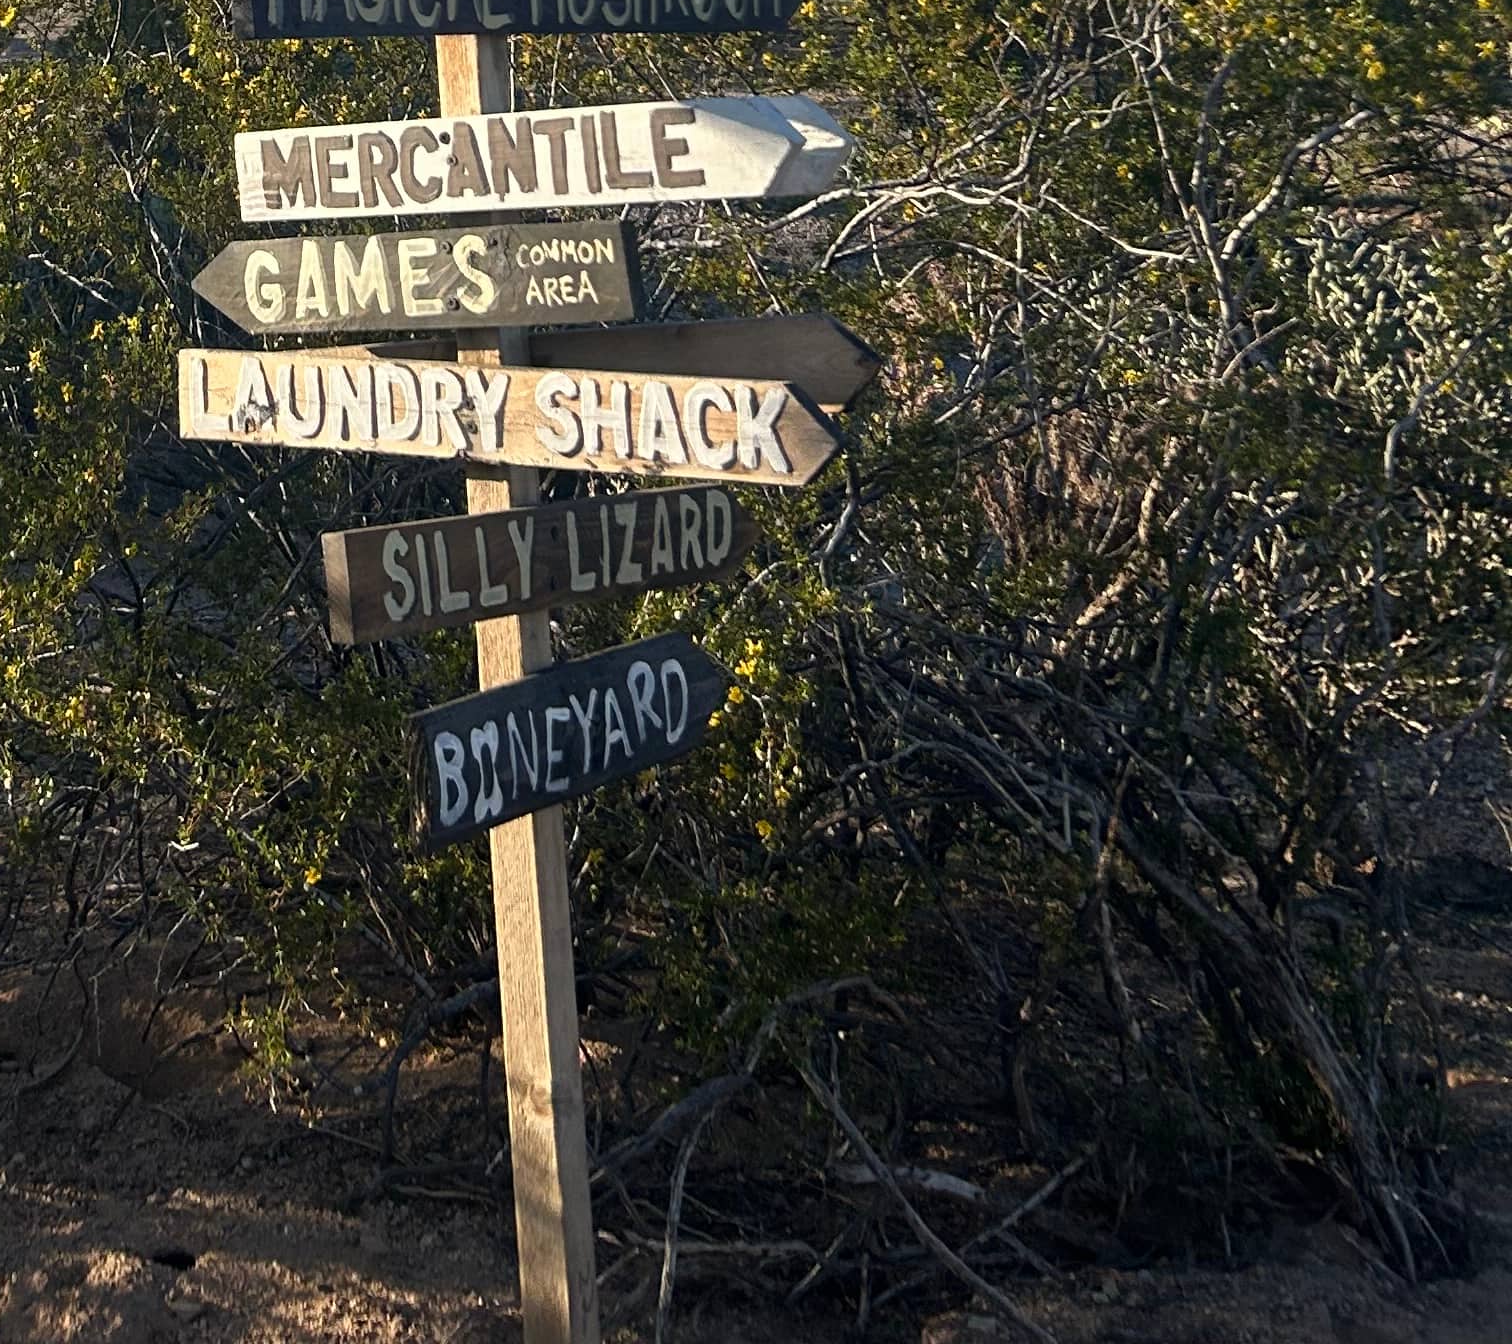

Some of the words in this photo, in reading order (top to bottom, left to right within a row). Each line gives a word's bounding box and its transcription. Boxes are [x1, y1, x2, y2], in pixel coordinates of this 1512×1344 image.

[260, 107, 706, 210] MERCANTILE
[244, 234, 496, 324] GAMES
[516, 237, 615, 268] COMMON
[525, 273, 599, 307] AREA
[190, 356, 512, 452] LAUNDRY
[534, 371, 793, 474] SHACK
[383, 517, 534, 621] SILLY
[566, 489, 733, 592] LIZARD
[433, 658, 689, 827] BONEYARD
